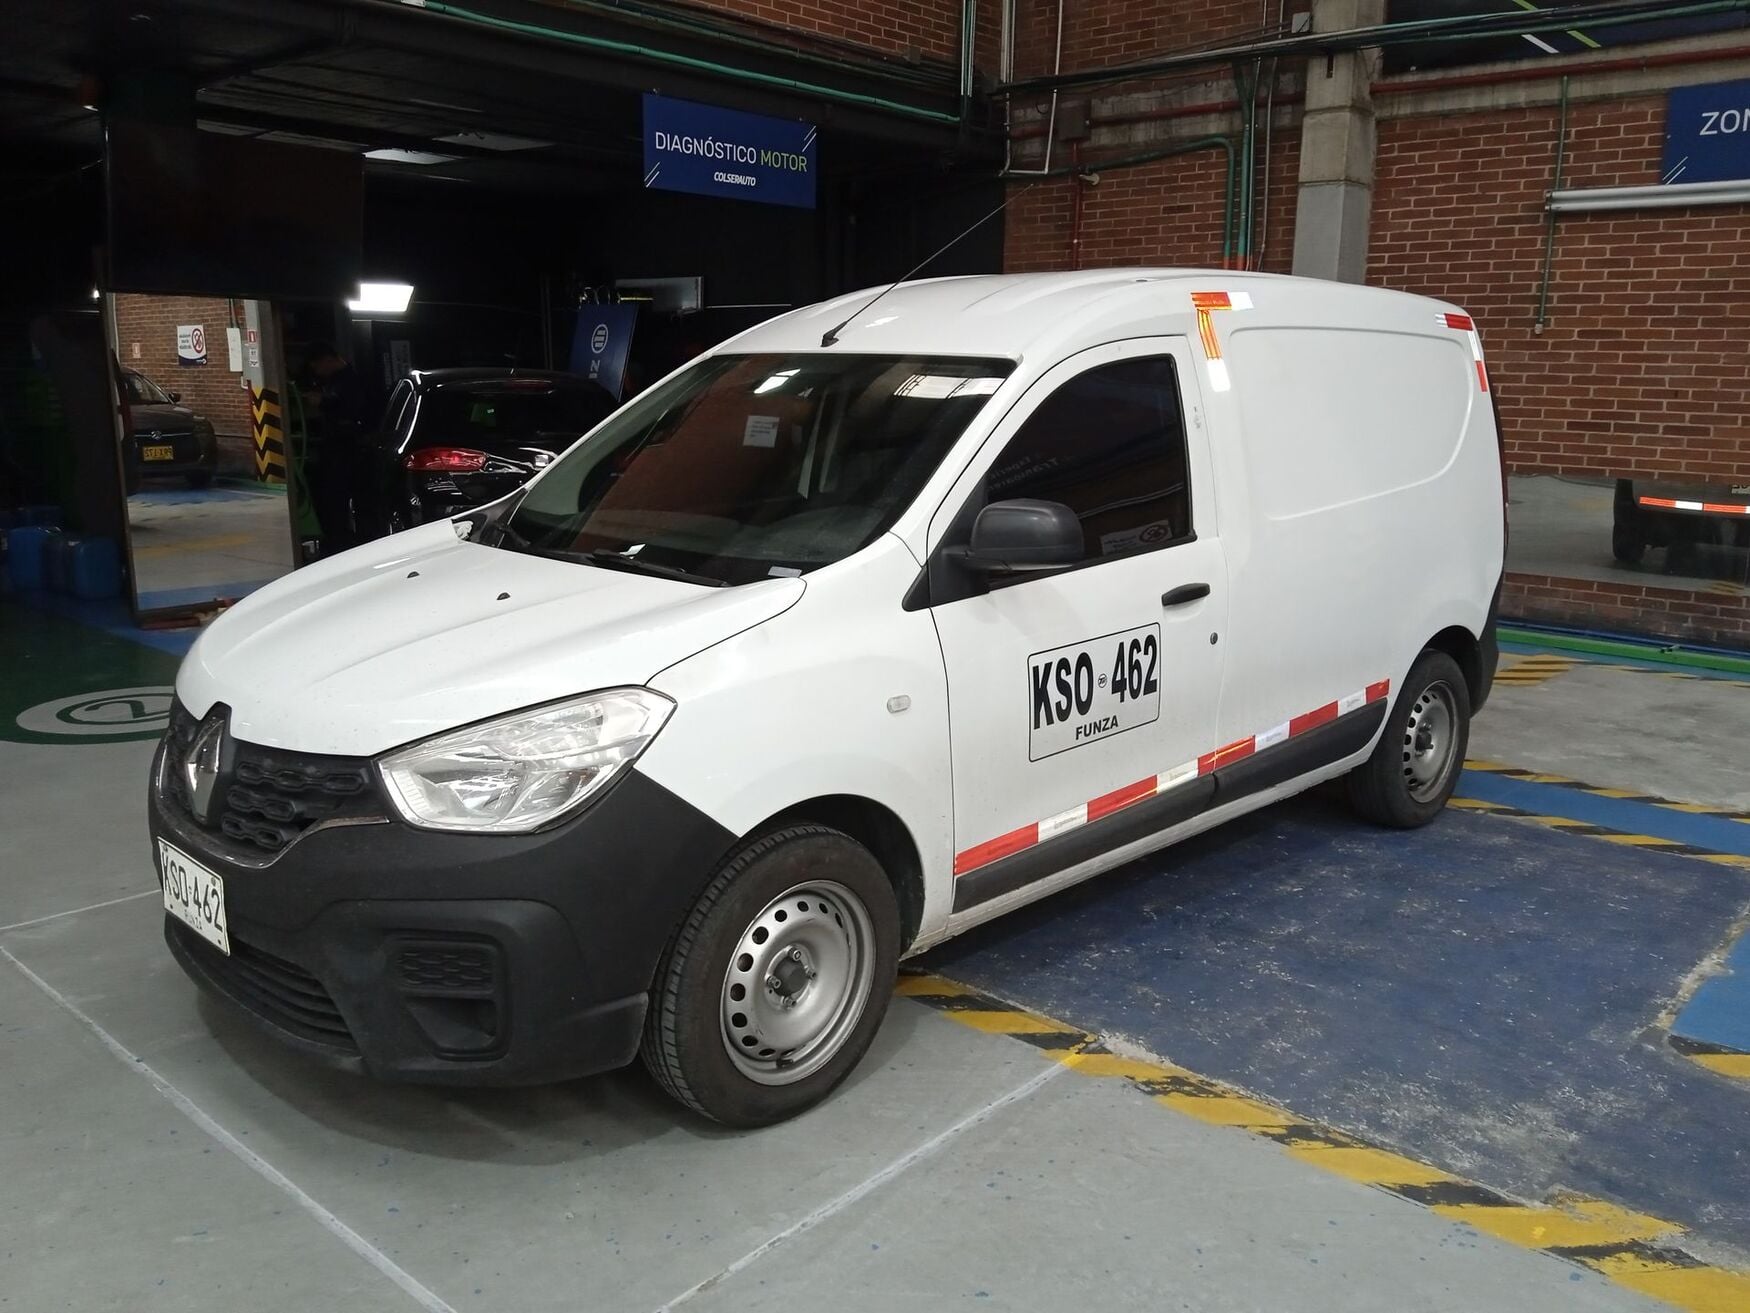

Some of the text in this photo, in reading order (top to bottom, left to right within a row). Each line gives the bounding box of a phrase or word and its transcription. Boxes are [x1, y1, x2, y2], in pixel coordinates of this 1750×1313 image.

[655, 131, 808, 172] DIAGNÓSTICO MOTOR
[713, 171, 756, 187] COLSERAUTO
[1075, 714, 1119, 741] FUNZA
